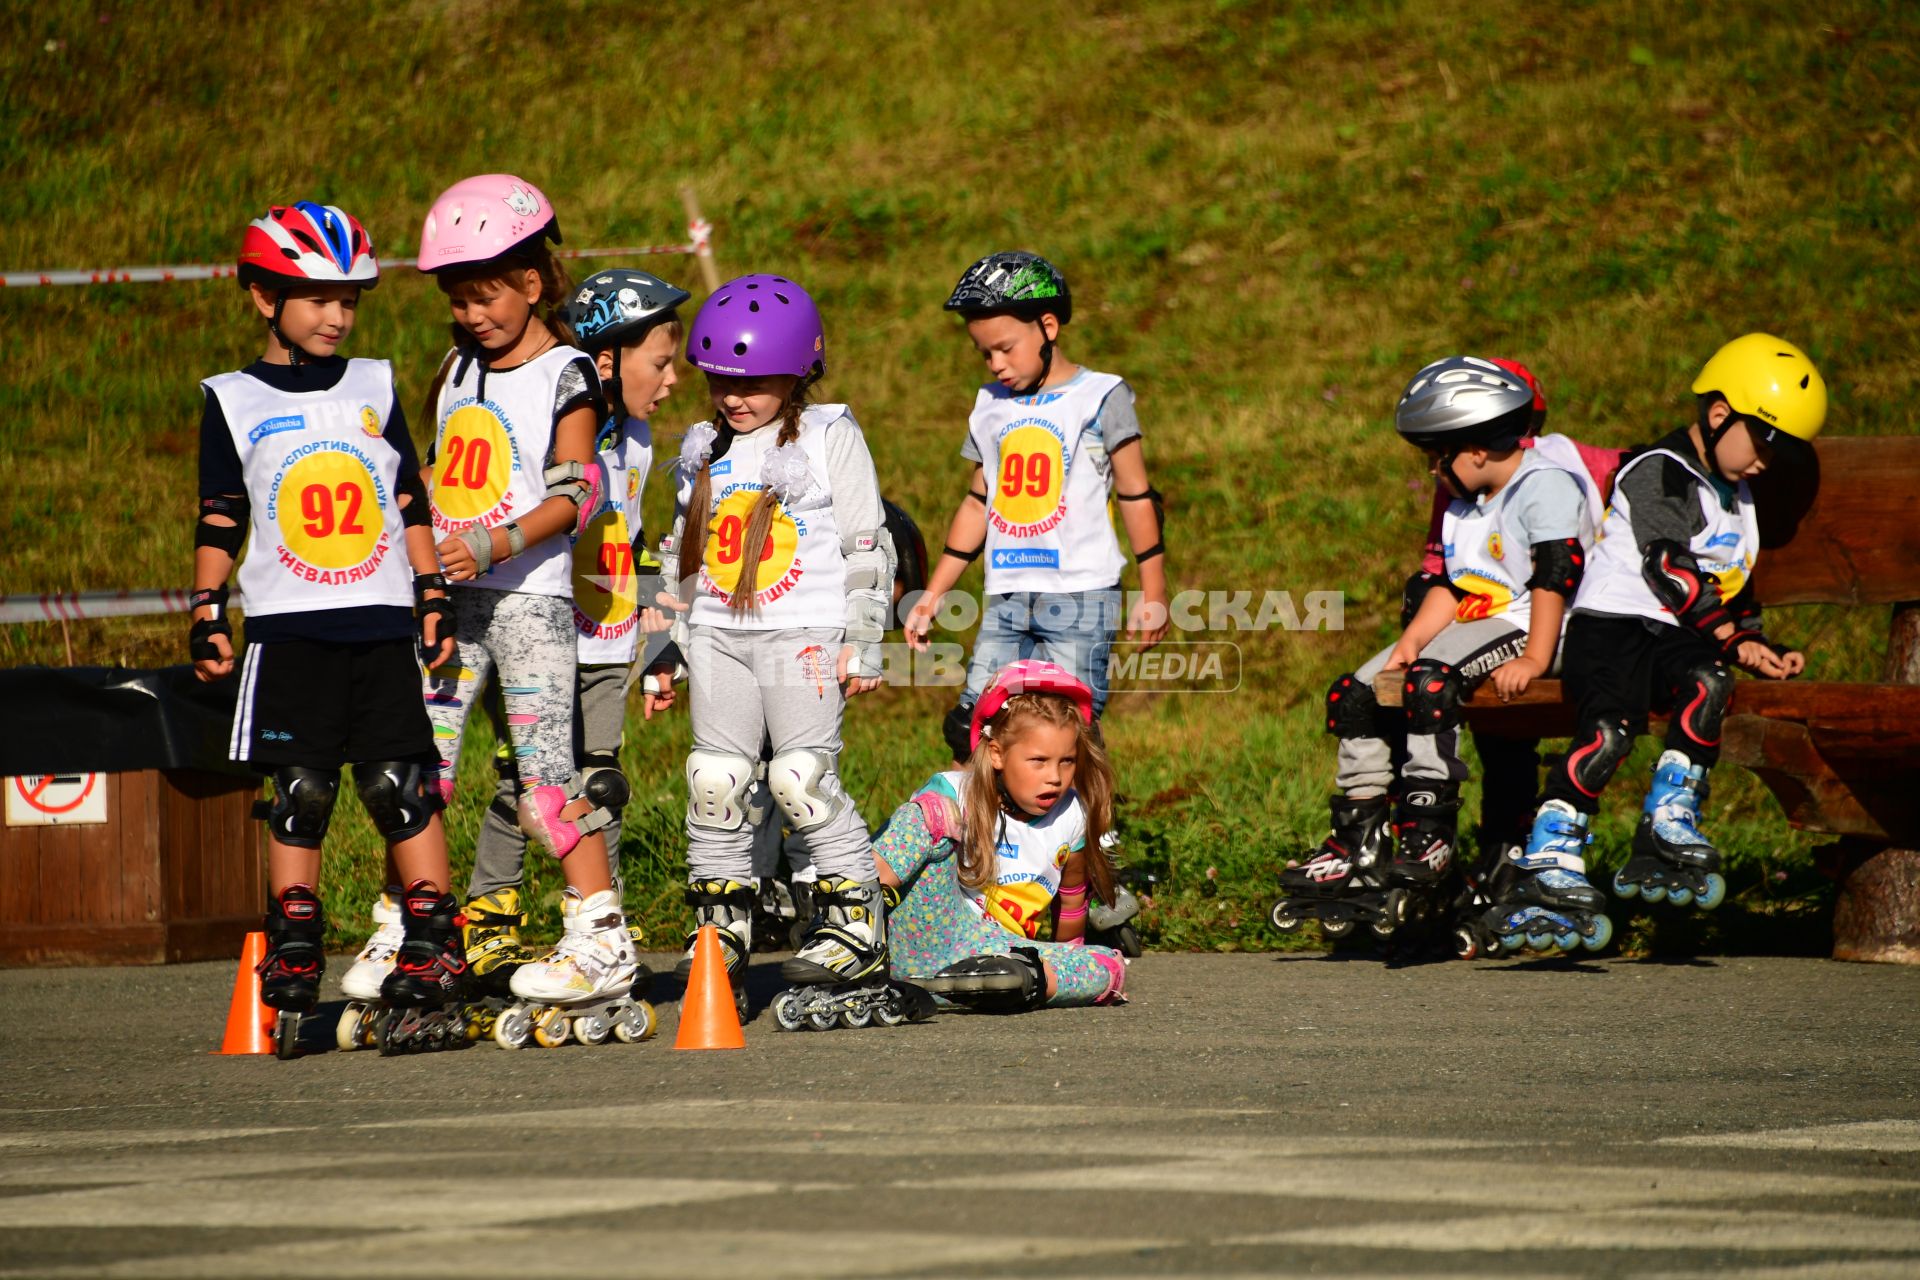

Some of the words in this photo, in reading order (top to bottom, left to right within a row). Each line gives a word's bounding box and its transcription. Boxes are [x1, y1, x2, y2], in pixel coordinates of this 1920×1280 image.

[258, 419, 302, 433] Columbia
[441, 436, 491, 489] 20
[510, 437, 522, 471] КЛУБ
[1001, 452, 1050, 498] 99
[267, 472, 282, 520] СРСОО
[301, 481, 364, 538] 92
[594, 542, 632, 593] 97
[1006, 553, 1056, 565] Columbia
[997, 872, 1057, 896] СПОРТИВНЫ
